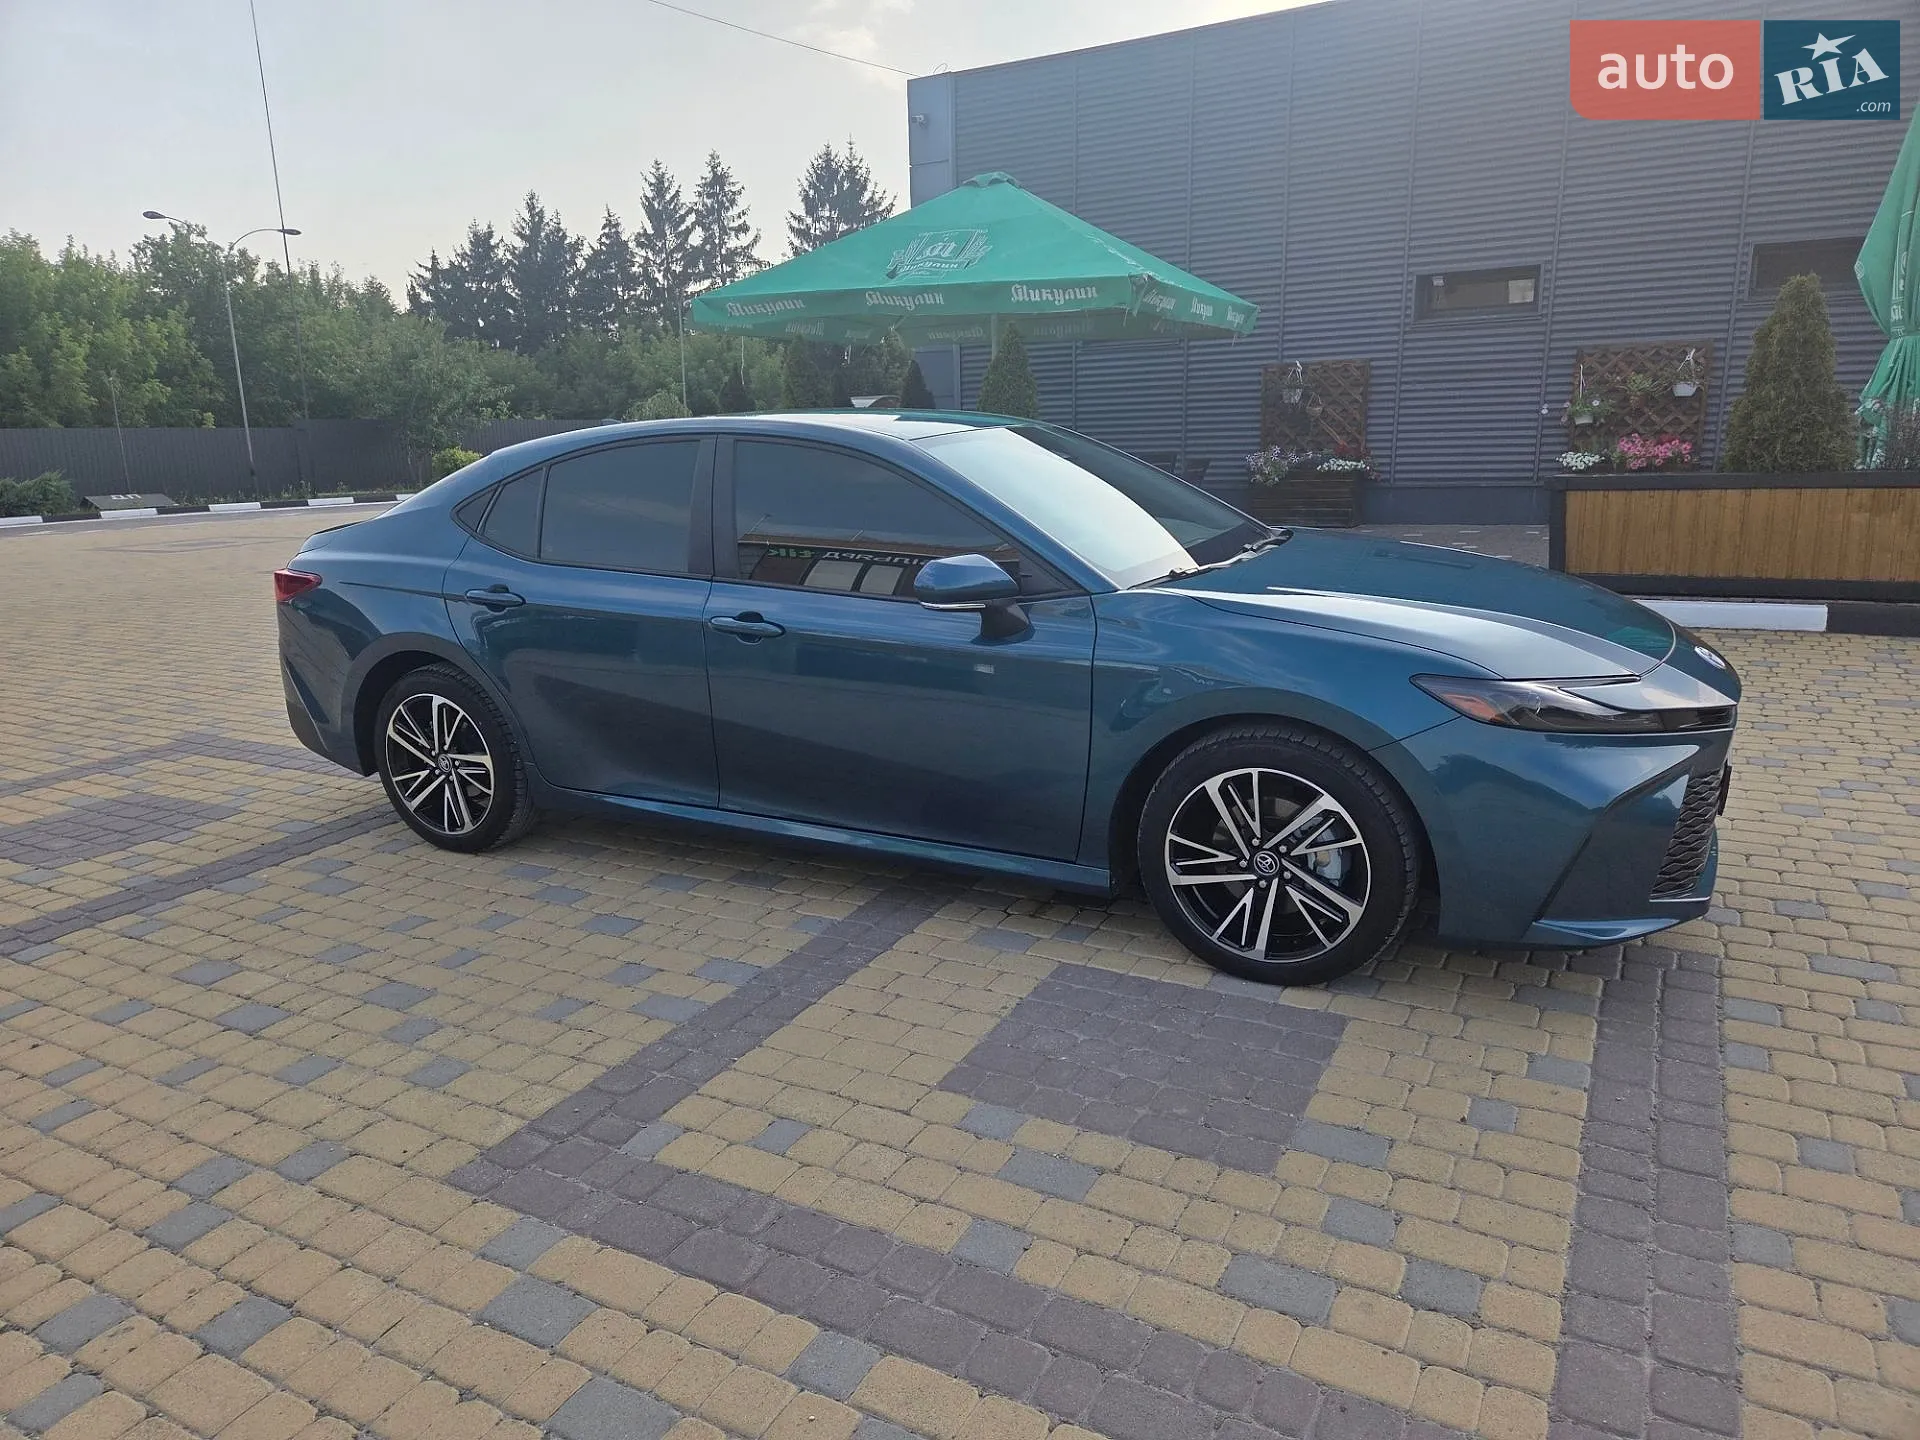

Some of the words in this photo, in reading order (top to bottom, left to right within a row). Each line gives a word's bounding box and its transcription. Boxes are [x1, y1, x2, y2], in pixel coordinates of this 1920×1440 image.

[866, 291, 945, 311] Микулин
[1012, 284, 1098, 305] Микулин
[727, 298, 806, 317] Микулин
